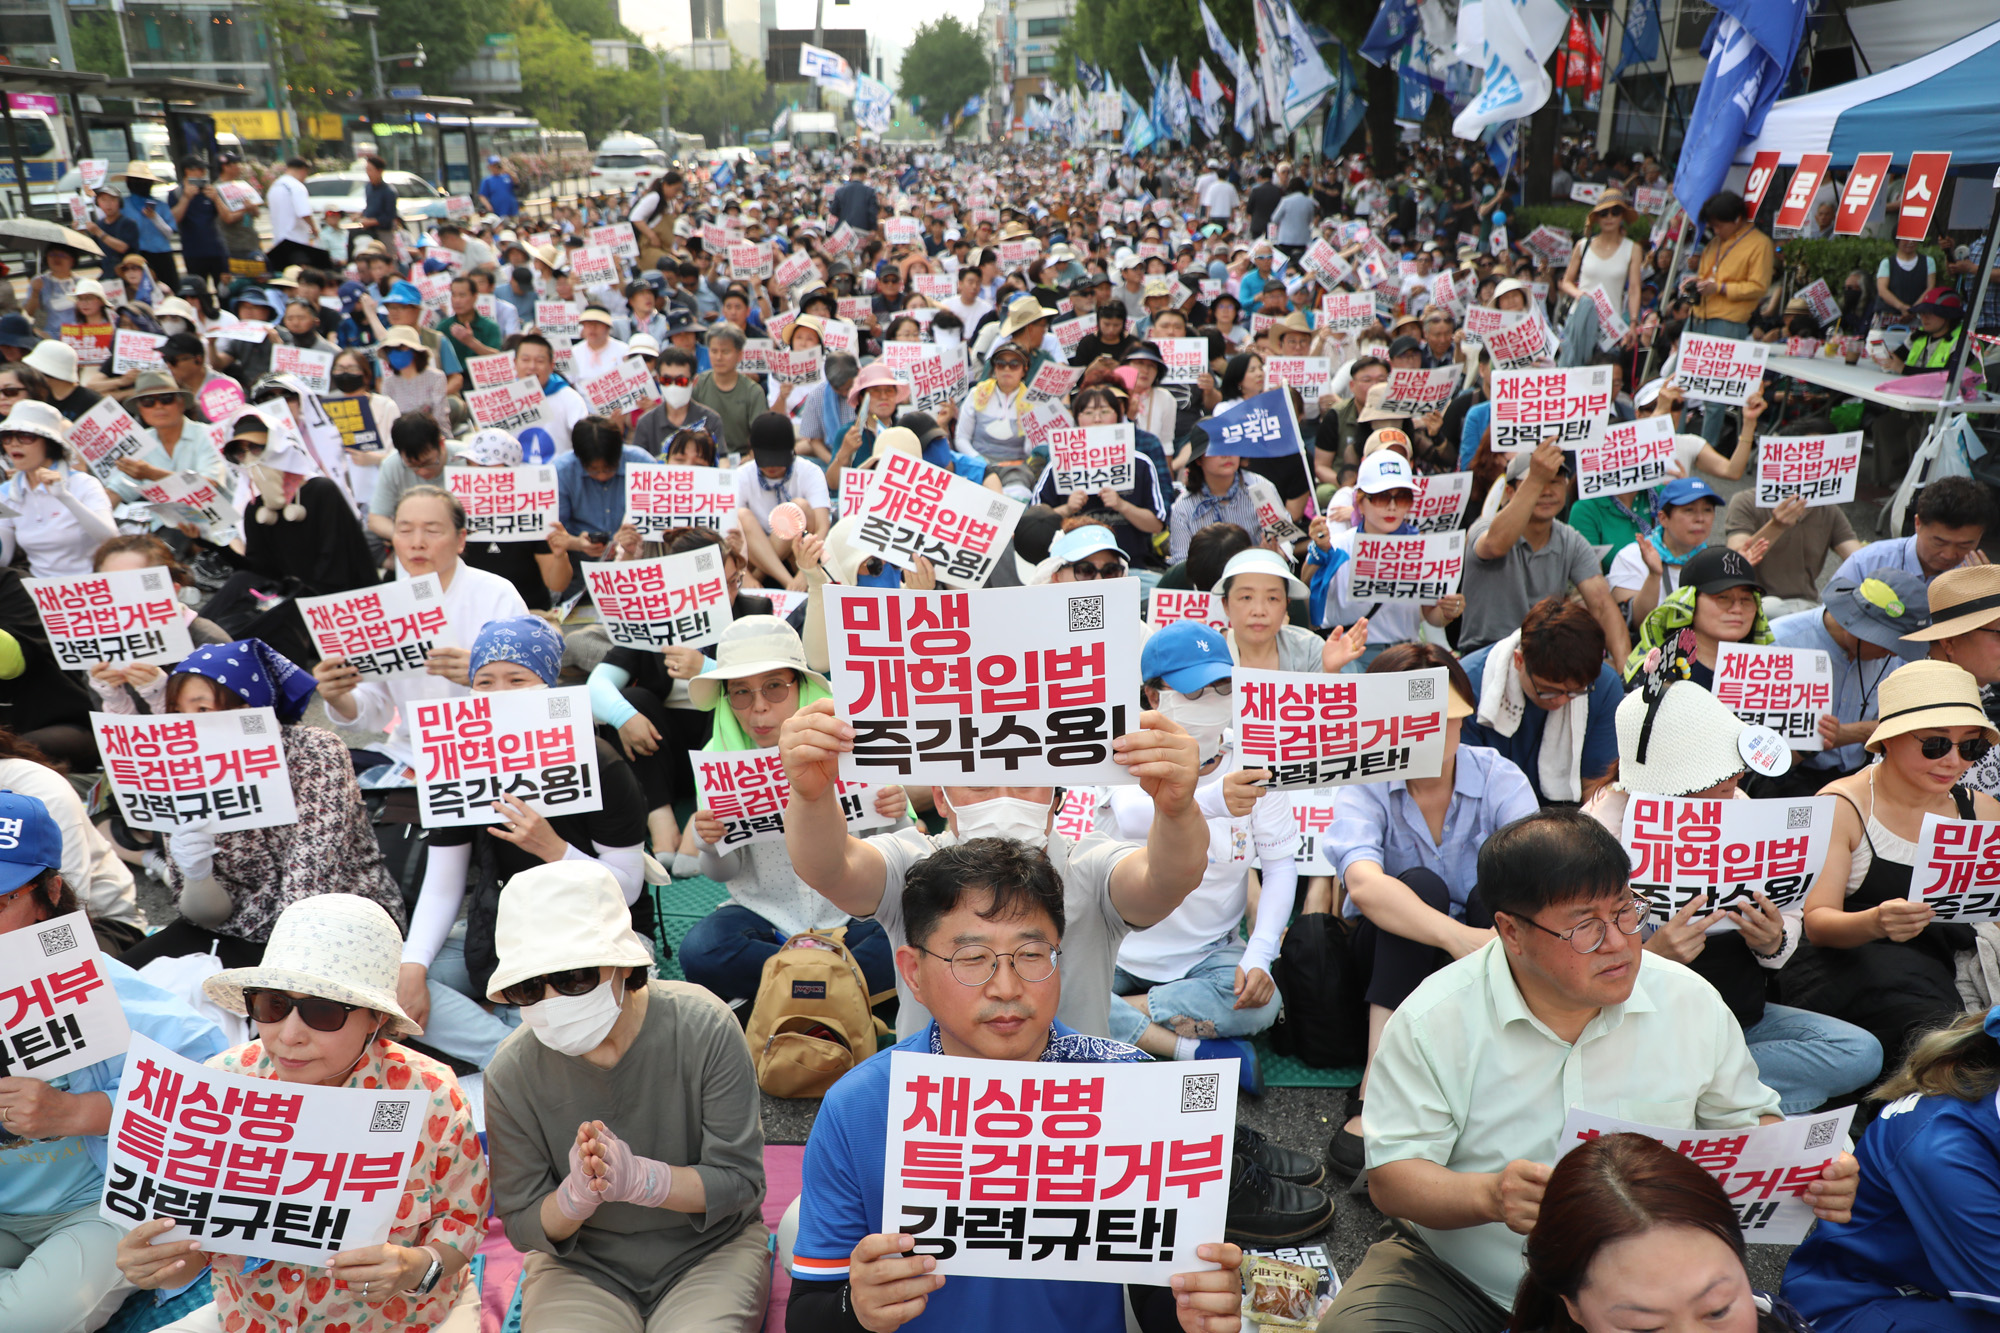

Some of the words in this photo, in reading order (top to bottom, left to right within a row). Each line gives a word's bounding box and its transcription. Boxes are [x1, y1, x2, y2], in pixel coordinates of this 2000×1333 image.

[1326, 295, 1349, 307] 민생
[1328, 304, 1372, 320] 개혁입법
[1469, 309, 1502, 324] 채상병
[824, 334, 848, 349] 입법
[1489, 317, 1538, 349] 채상병
[471, 356, 510, 371] 채상병
[887, 345, 921, 358] 채상병
[1162, 352, 1201, 366] 혁입법
[1684, 339, 1736, 360] 채상병
[475, 368, 514, 385] 특검법
[912, 355, 942, 380] 민생
[915, 361, 965, 398] 개혁입법
[1165, 365, 1205, 379] 각수용!
[1269, 361, 1304, 373] 채상병
[1394, 370, 1430, 385] 민생
[1681, 357, 1762, 381] 특검법거부
[586, 370, 622, 395] 채상병
[591, 372, 649, 405] 특검법거부
[1386, 381, 1453, 401] 개혁입법
[1497, 373, 1567, 399] 채상병
[1678, 375, 1746, 398] 강력규탄!
[471, 388, 511, 409] 채상병
[476, 392, 544, 423] 특검법거부
[1497, 392, 1607, 422] 특검법거부
[69, 417, 100, 449] 채상병
[82, 413, 133, 463] 특검법거부
[1051, 429, 1087, 452] 민생
[1054, 443, 1127, 471] 개혁입법
[1582, 438, 1676, 472] 특검법거부
[1763, 440, 1825, 461] 채상병
[451, 470, 516, 494] 채상병
[631, 470, 694, 492] 채상병
[883, 453, 952, 502] 민생
[1057, 463, 1132, 490] 즉각수용!
[1583, 461, 1666, 493] 강력규탄!
[1762, 454, 1858, 482] 특검법거부
[455, 489, 557, 516] 특검법거부
[631, 493, 735, 514] 특검법거부
[1761, 478, 1842, 502] 강력규탄!
[869, 484, 998, 554] 개혁입법
[1409, 494, 1461, 518] 혁입법
[859, 514, 992, 582] 즉각수용!
[1356, 540, 1426, 560] 채상병
[589, 563, 665, 595] 채상병
[1355, 555, 1462, 581] 특검법거부
[33, 578, 112, 613] 채상병
[597, 577, 725, 620] 특검법거부
[1353, 580, 1447, 599] 강력규탄!
[44, 598, 178, 639] 특검법거부
[306, 592, 386, 633] 채상병
[1156, 592, 1211, 619] 민생
[317, 605, 448, 657] 특검법거부
[607, 611, 711, 646] 강력규탄!
[841, 592, 971, 656] 민생
[55, 630, 167, 664] 강력규탄!
[845, 642, 1106, 718] 개혁입법
[1720, 653, 1793, 680] 채상병
[1240, 681, 1357, 721] 채상병
[1716, 682, 1829, 710] 특검법거부
[417, 697, 493, 744] 민생
[1739, 712, 1815, 740] 력규탄!
[100, 719, 200, 758] 채상병
[852, 704, 1126, 775] 즉각수용!
[1241, 711, 1440, 762] 특검법거부
[110, 744, 281, 793] 특검법거부
[422, 725, 576, 782] 개혁입법
[121, 784, 261, 826] 강력규탄!
[429, 763, 592, 818] 즉각수용!
[1634, 799, 1722, 842] 민생
[1630, 836, 1809, 884] 개혁입법
[127, 1058, 304, 1143] 채상병
[903, 1075, 1105, 1138] 채상병
[116, 1109, 405, 1203] 특검법거부
[901, 1134, 1223, 1202] 특검법거부
[105, 1163, 351, 1251] 강력규탄!
[899, 1205, 1178, 1261] 강력규탄!
